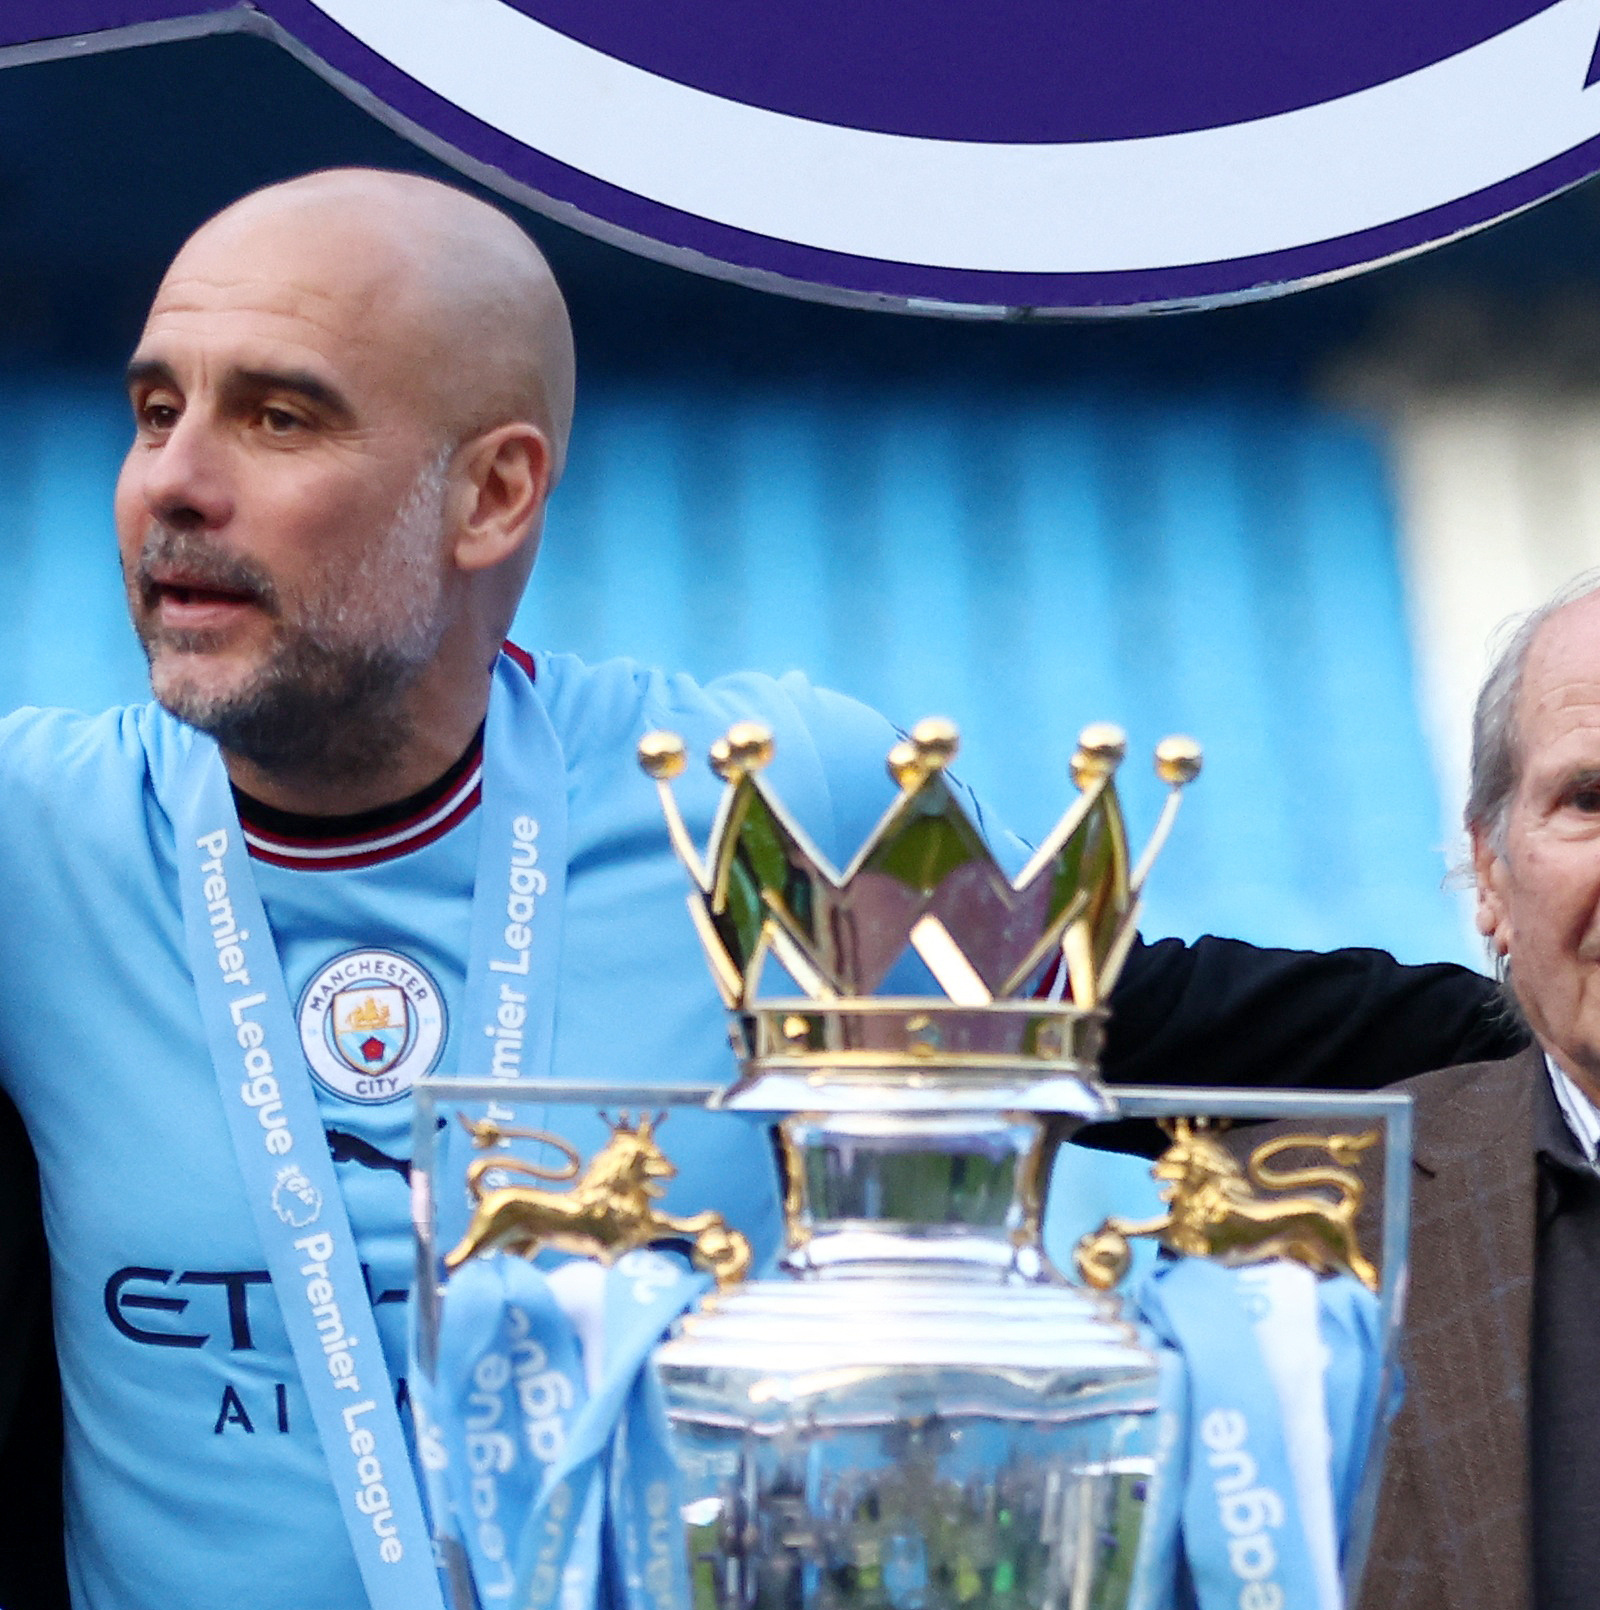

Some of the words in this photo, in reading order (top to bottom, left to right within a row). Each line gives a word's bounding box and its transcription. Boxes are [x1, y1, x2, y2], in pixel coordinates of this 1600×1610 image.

[488, 815, 548, 976] League
[196, 827, 251, 987] Premier
[228, 991, 293, 1157] League
[309, 960, 428, 1012] MANCHESTER
[355, 1077, 399, 1095] CITY
[294, 1231, 360, 1393] Premier
[342, 1399, 403, 1564] League
